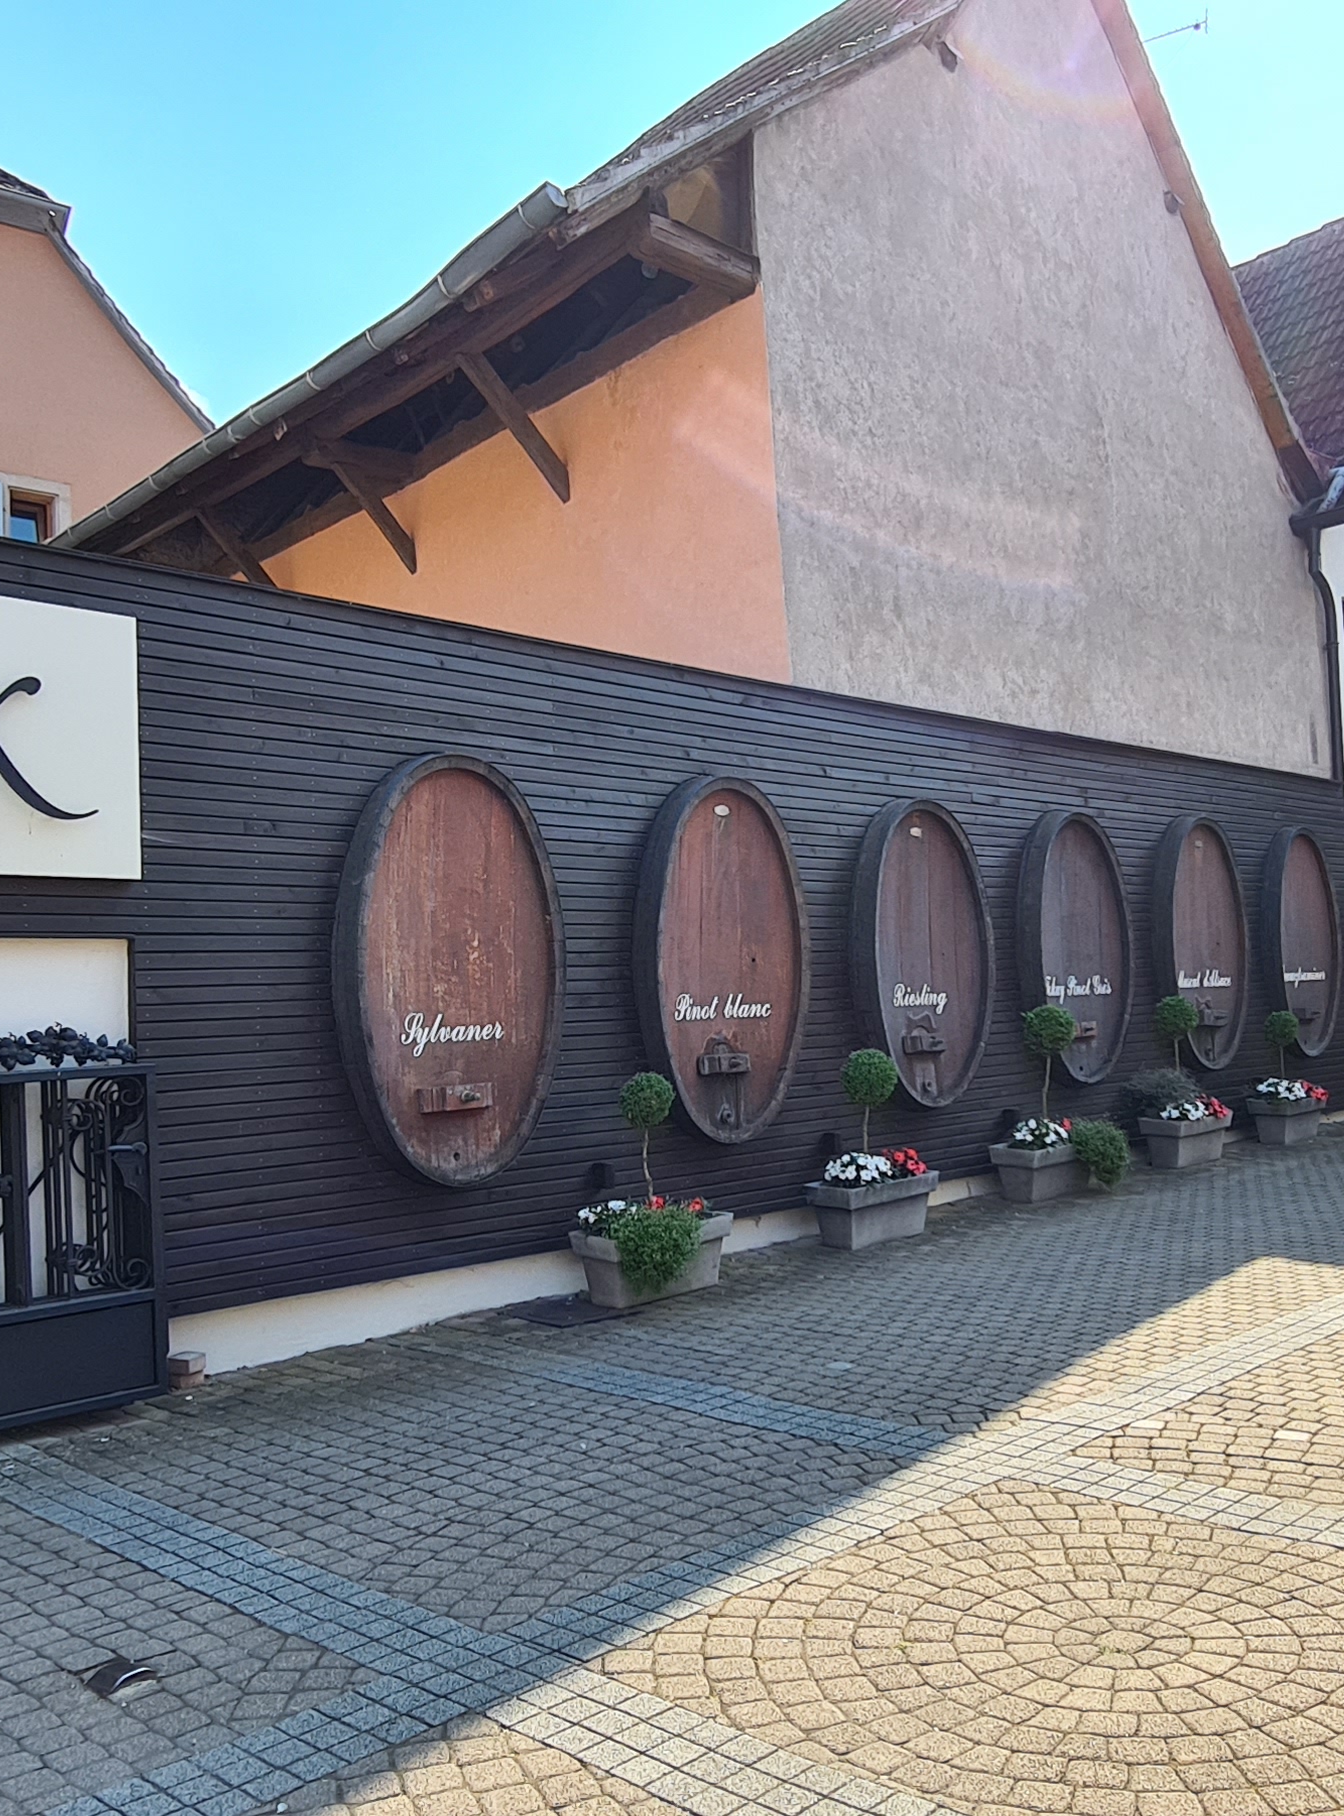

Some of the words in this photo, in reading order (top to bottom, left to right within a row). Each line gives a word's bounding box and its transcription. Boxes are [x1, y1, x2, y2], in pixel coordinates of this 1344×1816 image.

[674, 993, 719, 1021] Pinot
[723, 993, 772, 1019] blanc
[893, 983, 948, 1015] Riesling
[400, 1012, 505, 1057] Sylvaner
